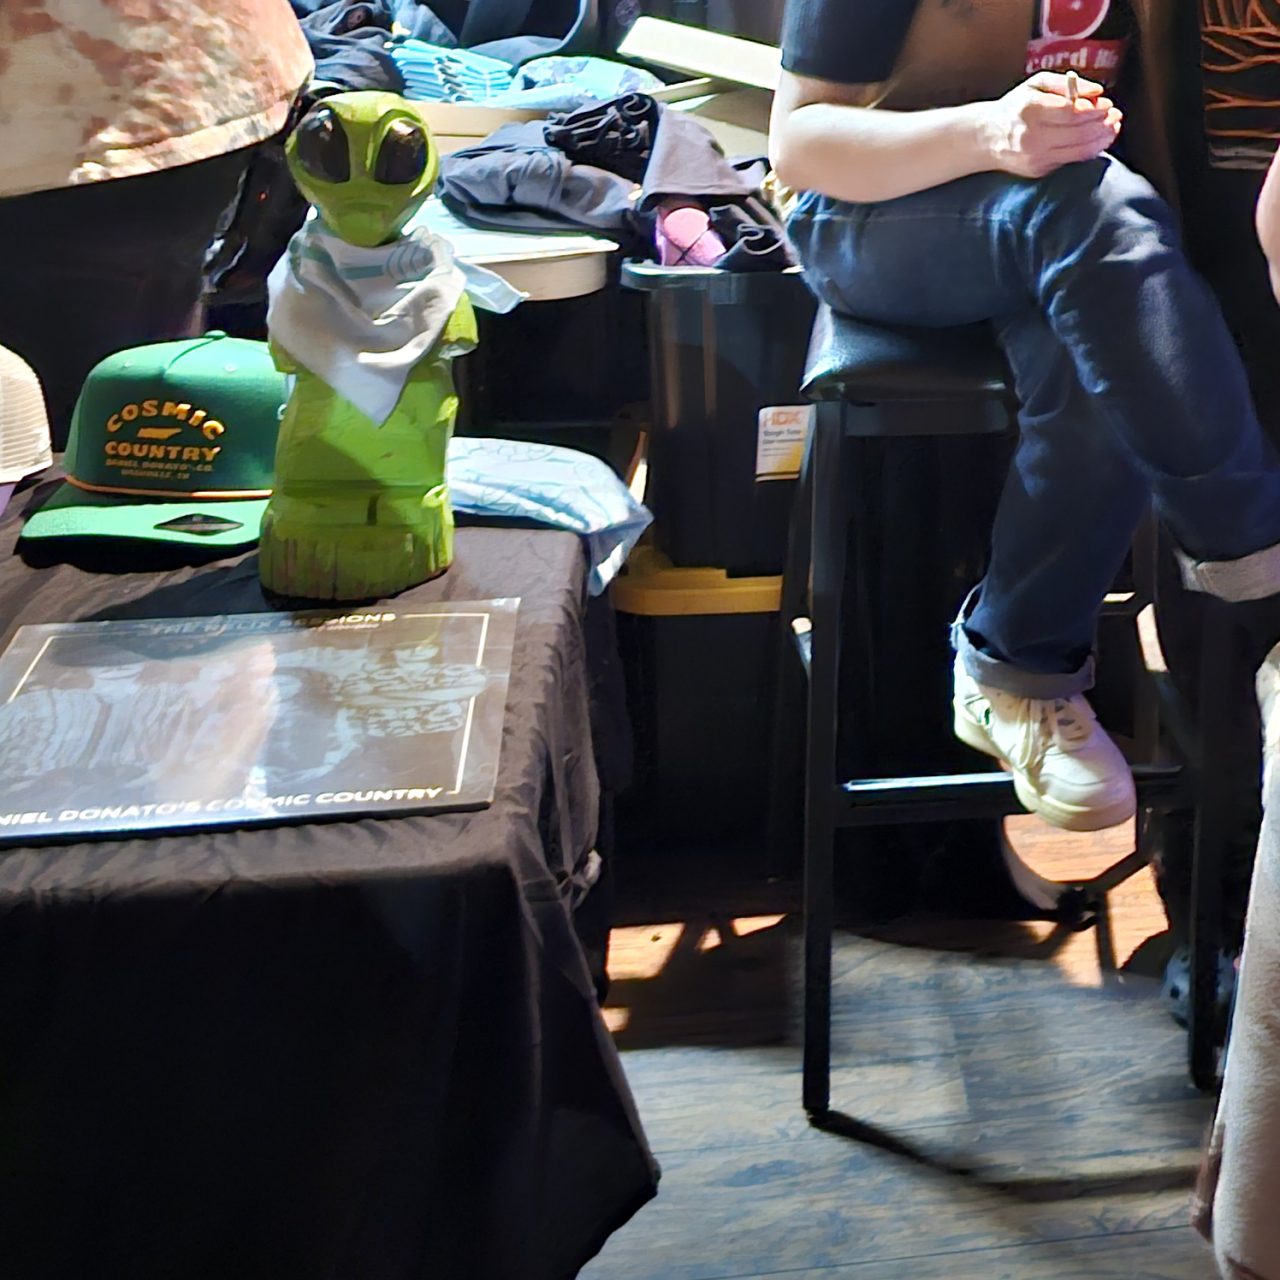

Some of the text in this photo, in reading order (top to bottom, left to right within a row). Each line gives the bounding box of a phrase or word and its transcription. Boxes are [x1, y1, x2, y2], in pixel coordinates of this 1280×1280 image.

[1026, 47, 1088, 74] cord
[106, 399, 225, 440] COSMIC
[104, 441, 221, 462] COUNTRY
[0, 787, 443, 826] NIEL DONATO'S COMIC COUNTRY
